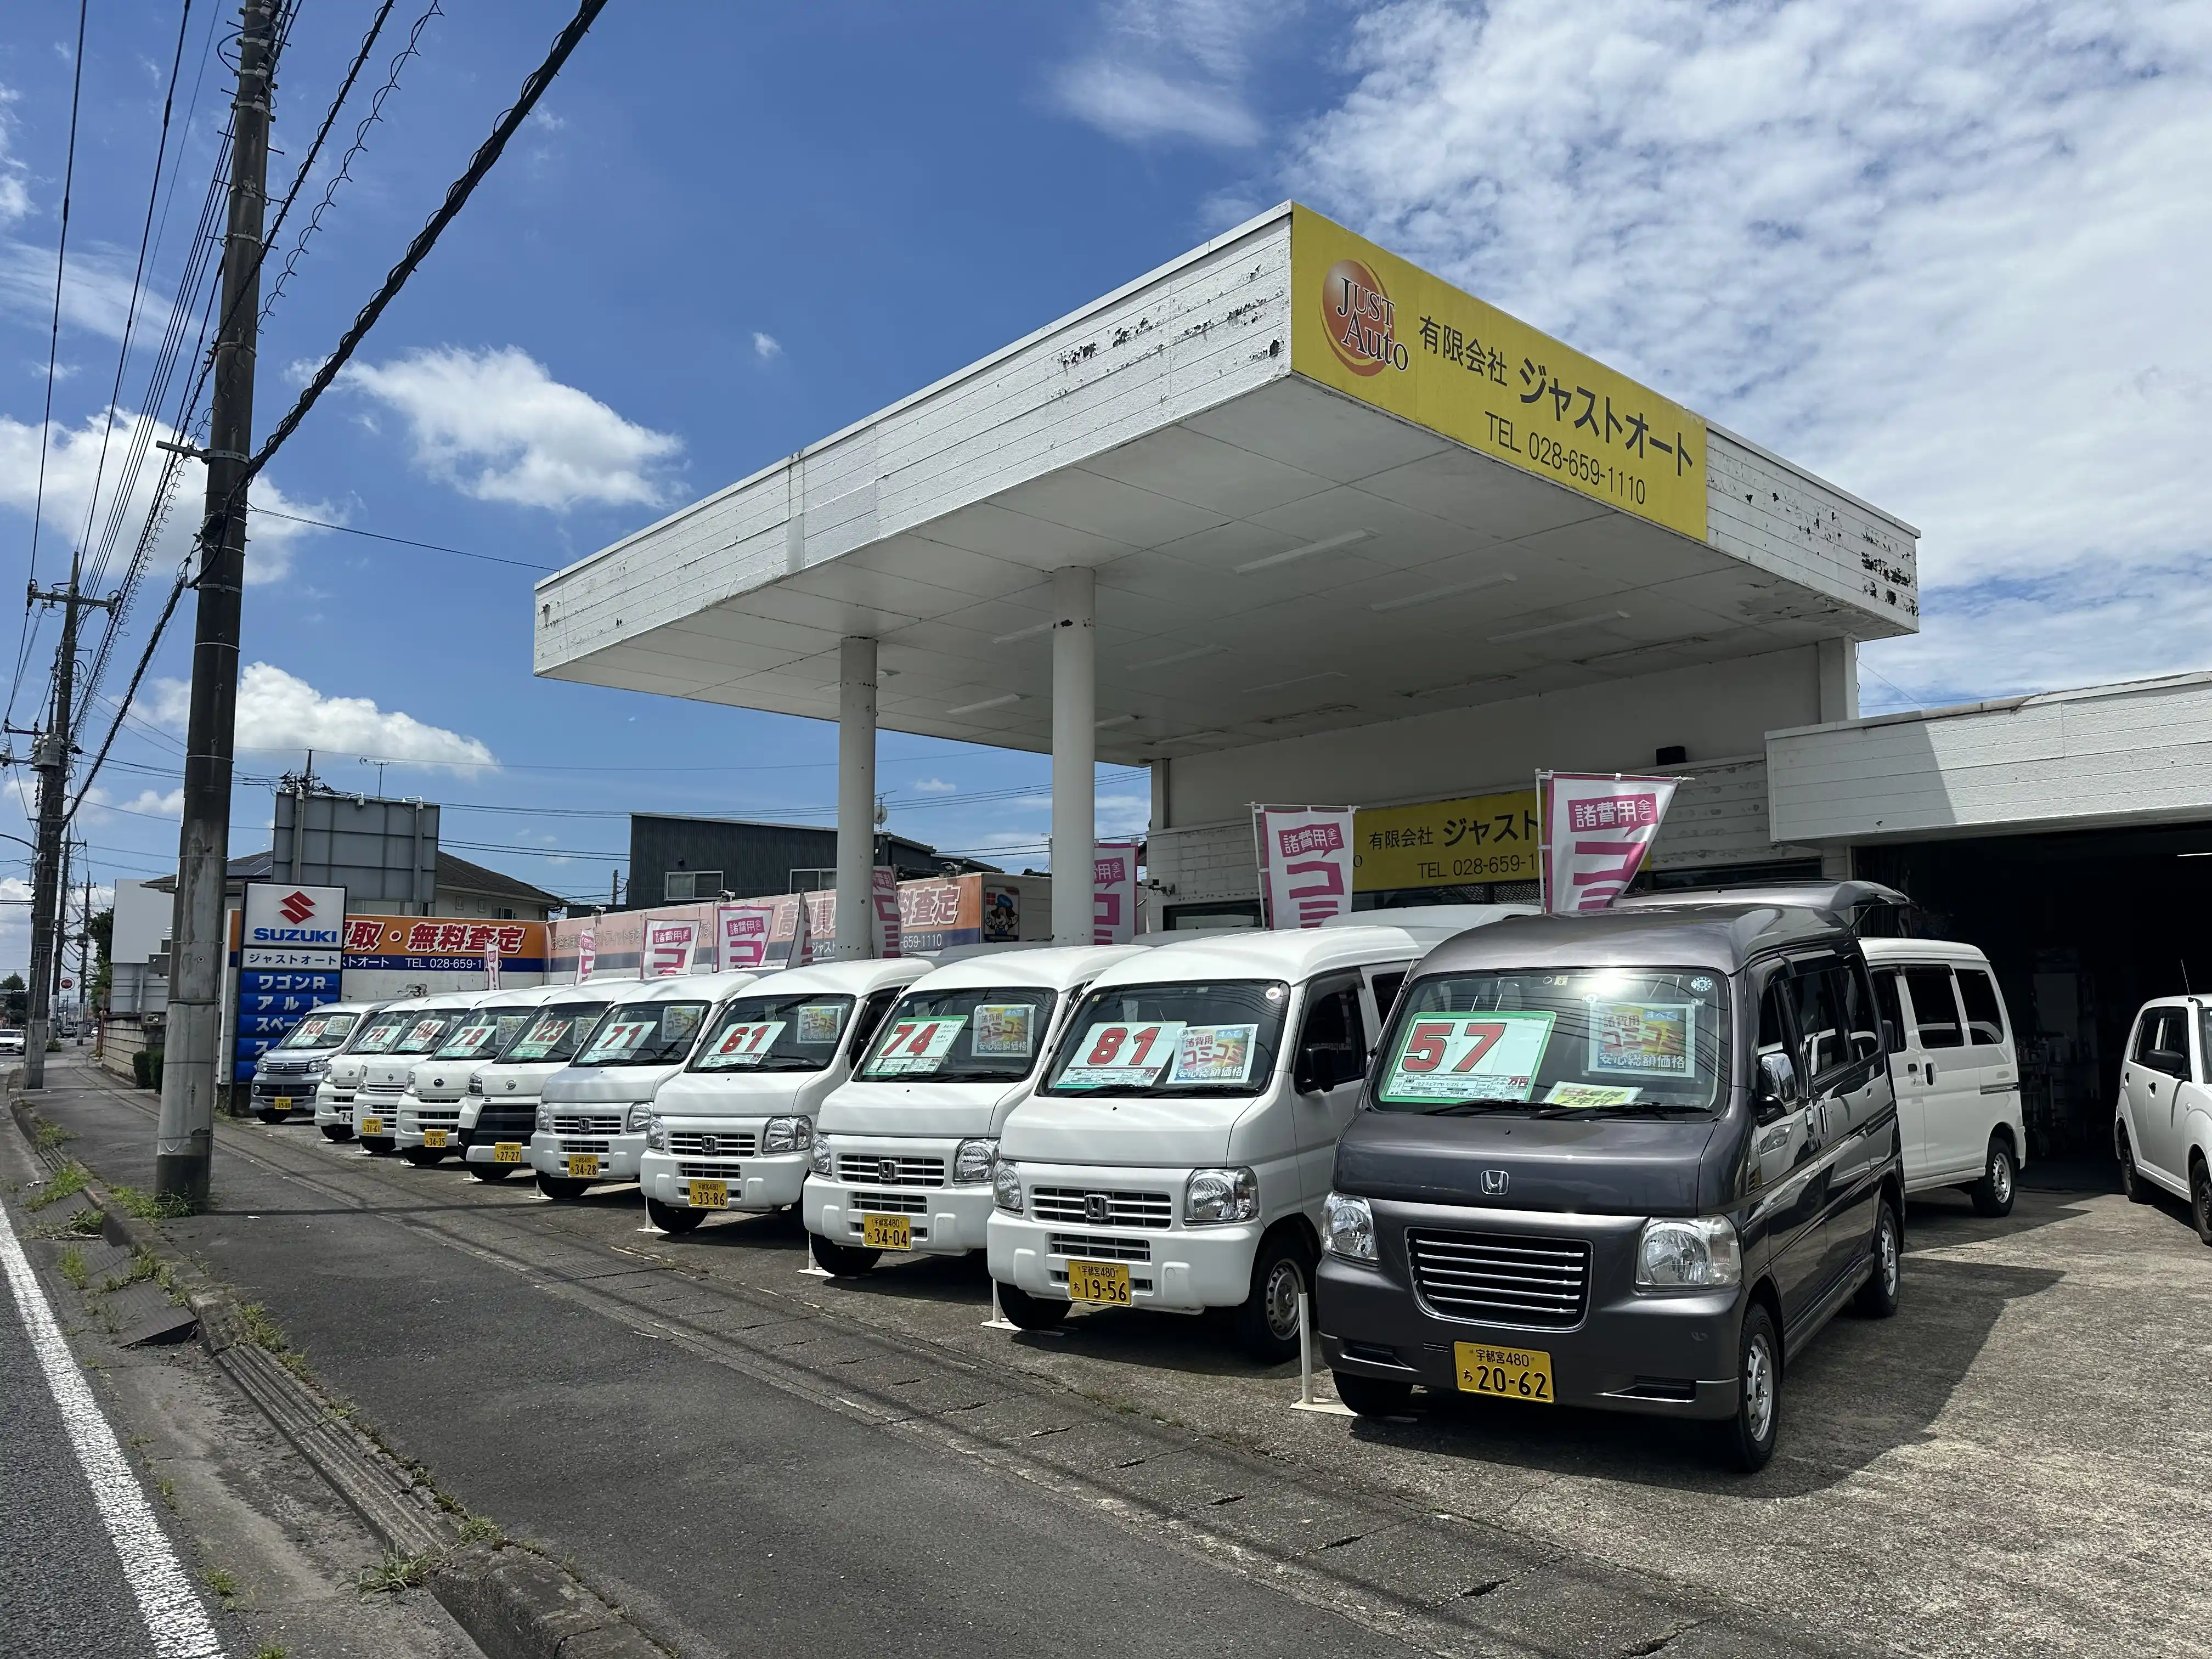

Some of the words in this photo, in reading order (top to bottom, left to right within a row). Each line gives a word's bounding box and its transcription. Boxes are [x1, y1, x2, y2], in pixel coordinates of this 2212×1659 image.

[1337, 277, 1395, 328] JUST
[1342, 311, 1408, 371] Auto
[1419, 315, 1507, 386] 有限会社
[1519, 357, 1693, 477] ジャストオート
[1485, 410, 1521, 453] TEL
[1529, 432, 1645, 505] 028-659-1110
[1369, 826, 1434, 850] 有限会社
[1417, 861, 1447, 879] TEL
[253, 928, 337, 943] SUZUKI
[345, 920, 526, 954] 取・無料査定
[249, 953, 337, 966] ジャストオート
[405, 958, 426, 968] TEL
[258, 975, 326, 990] ワゴンR
[257, 996, 325, 1011] アルト
[256, 1017, 303, 1032] スペー
[1646, 1011, 1674, 1020] すべて
[452, 1029, 487, 1046] 78
[528, 1021, 568, 1042] 123
[600, 1024, 645, 1049] 71
[719, 1024, 771, 1053] 61
[879, 1023, 941, 1057] 74
[1218, 1030, 1241, 1039] すべて
[1601, 1025, 1683, 1051] コミコミ
[1087, 1026, 1162, 1065] 81
[1183, 1043, 1245, 1066] コミコミ
[1401, 1022, 1508, 1073] 57
[1599, 1052, 1685, 1069] 安心総額価格
[428, 1137, 445, 1147] 34-35
[500, 1151, 520, 1161] 27-27
[574, 1164, 597, 1175] 34-28
[698, 1191, 725, 1206] 33-86
[873, 1227, 908, 1246] 34-04
[1073, 1282, 1080, 1293] ち
[1084, 1277, 1127, 1301] 19-56
[1463, 1369, 1473, 1383] ち
[1476, 1364, 1548, 1398] 20-62
